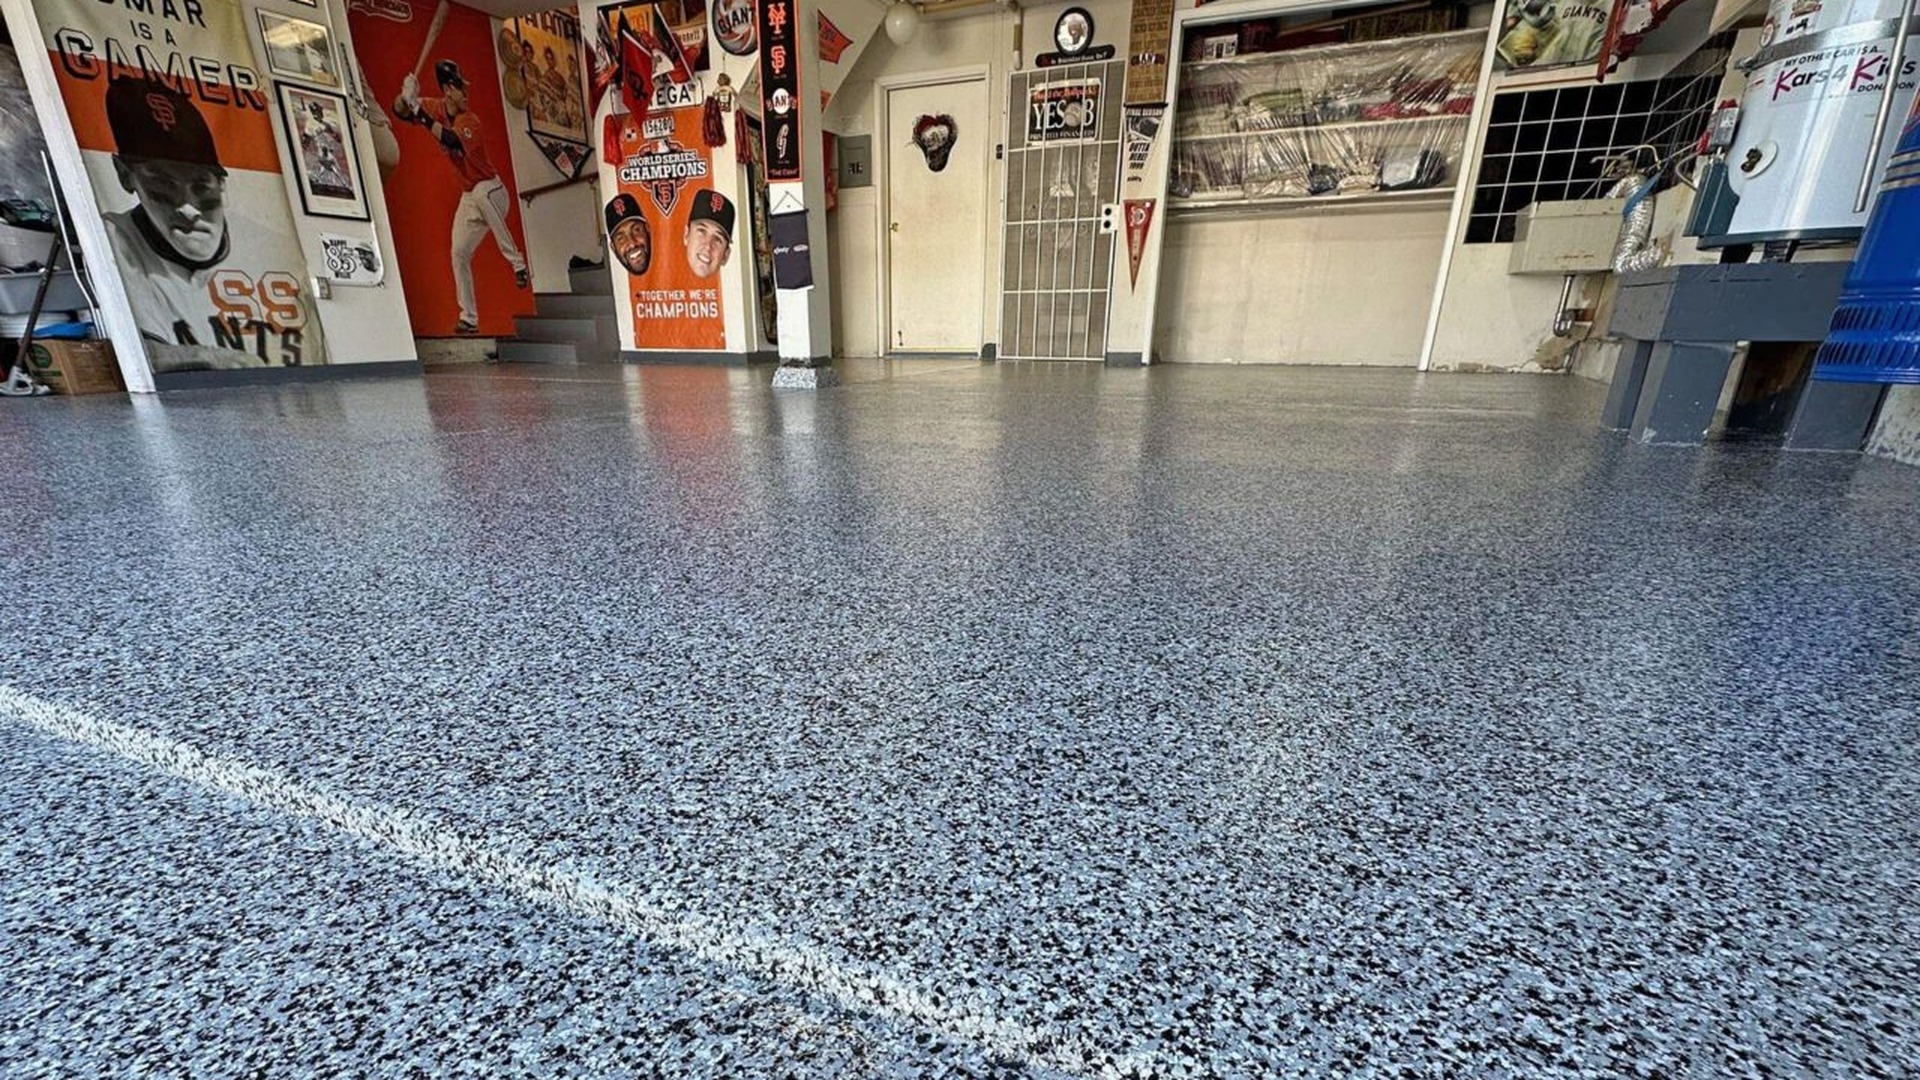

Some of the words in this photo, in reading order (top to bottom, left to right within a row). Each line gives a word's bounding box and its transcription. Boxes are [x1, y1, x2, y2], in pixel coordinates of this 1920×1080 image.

[1562, 5, 1608, 24] GIANTS
[130, 20, 152, 40] IS
[165, 28, 178, 46] A
[1783, 58, 1799, 67] MY
[1799, 51, 1832, 65] OTHER
[1833, 48, 1855, 59] CAR
[55, 27, 265, 111] GAMER
[1772, 68, 1828, 101] Kars
[1831, 64, 1850, 82] 4
[648, 82, 692, 106] EGA
[1032, 100, 1067, 130] YES
[628, 154, 662, 167] WORLD
[663, 152, 696, 164] SERIES
[621, 161, 707, 181] CHAMPIONS
[325, 245, 357, 274] 85
[641, 290, 686, 301] TOGETHER
[636, 301, 718, 318] CHAMPIONS
